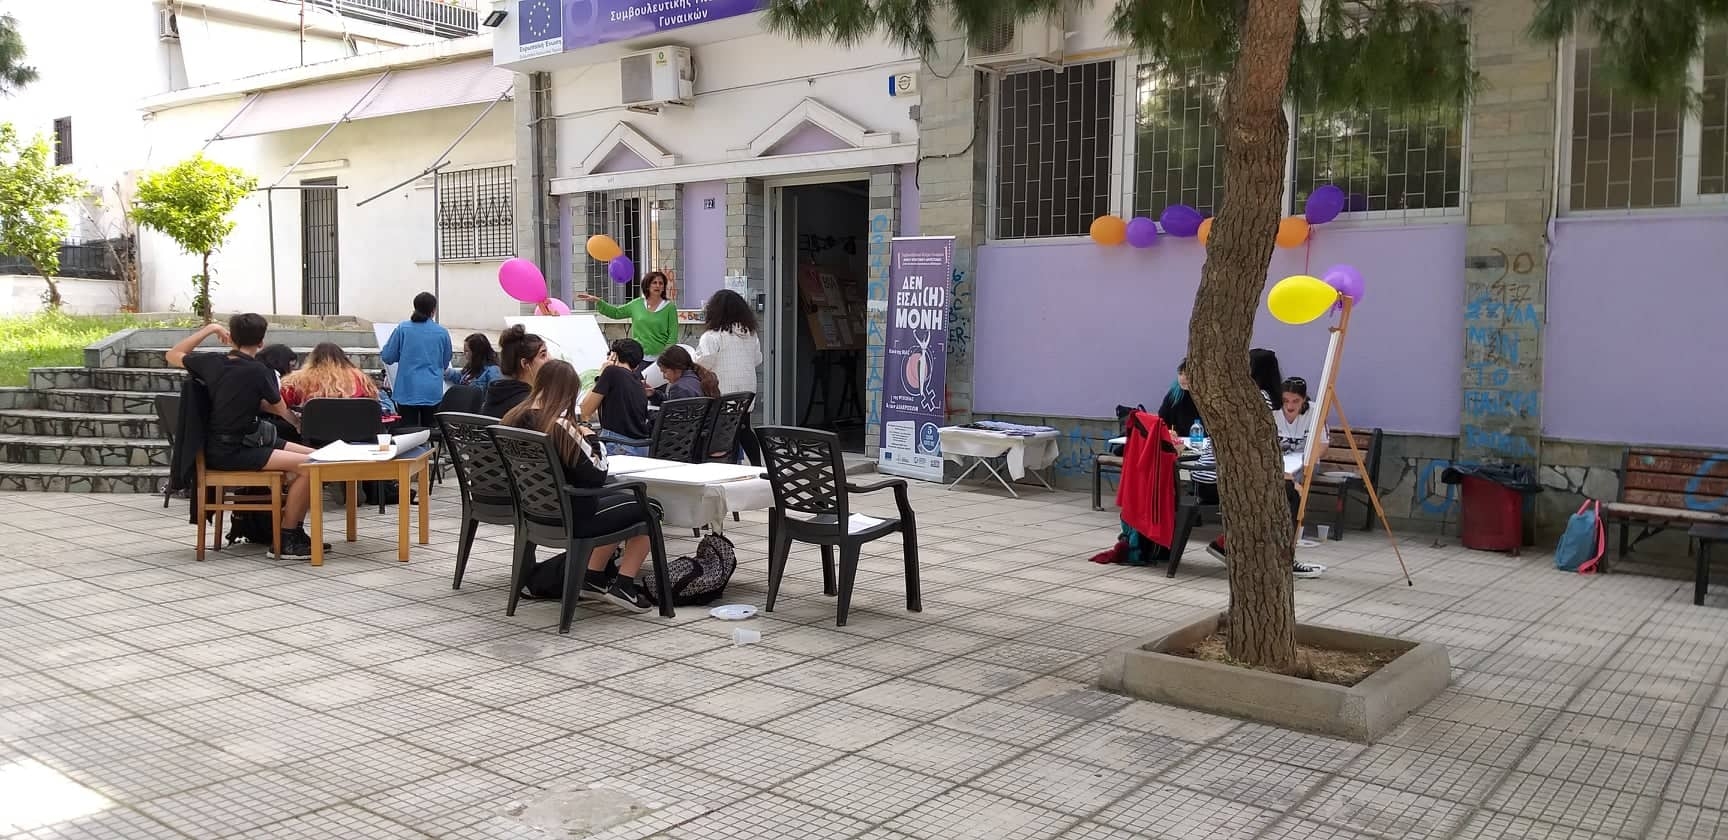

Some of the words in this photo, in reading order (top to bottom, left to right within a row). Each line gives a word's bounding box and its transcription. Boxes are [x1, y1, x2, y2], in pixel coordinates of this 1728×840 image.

[659, 8, 708, 27] Γυναικών
[902, 276, 923, 290] ΔΕΝ
[895, 308, 943, 331] ΜΟΝΗ
[927, 425, 933, 435] 5
